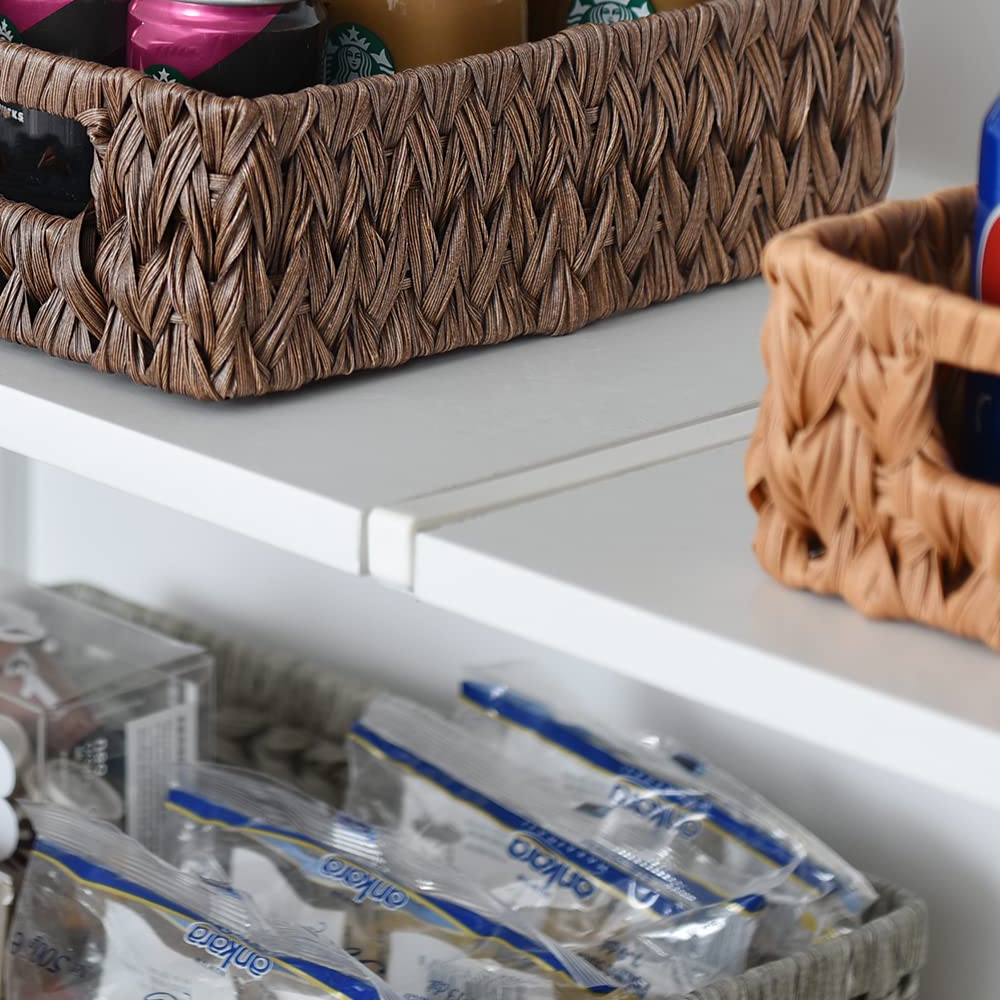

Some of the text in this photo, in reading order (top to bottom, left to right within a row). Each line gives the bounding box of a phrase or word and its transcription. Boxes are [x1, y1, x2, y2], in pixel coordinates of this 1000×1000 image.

[321, 854, 408, 909] ankara
[507, 836, 596, 900] ankara
[187, 922, 272, 977] ankara
